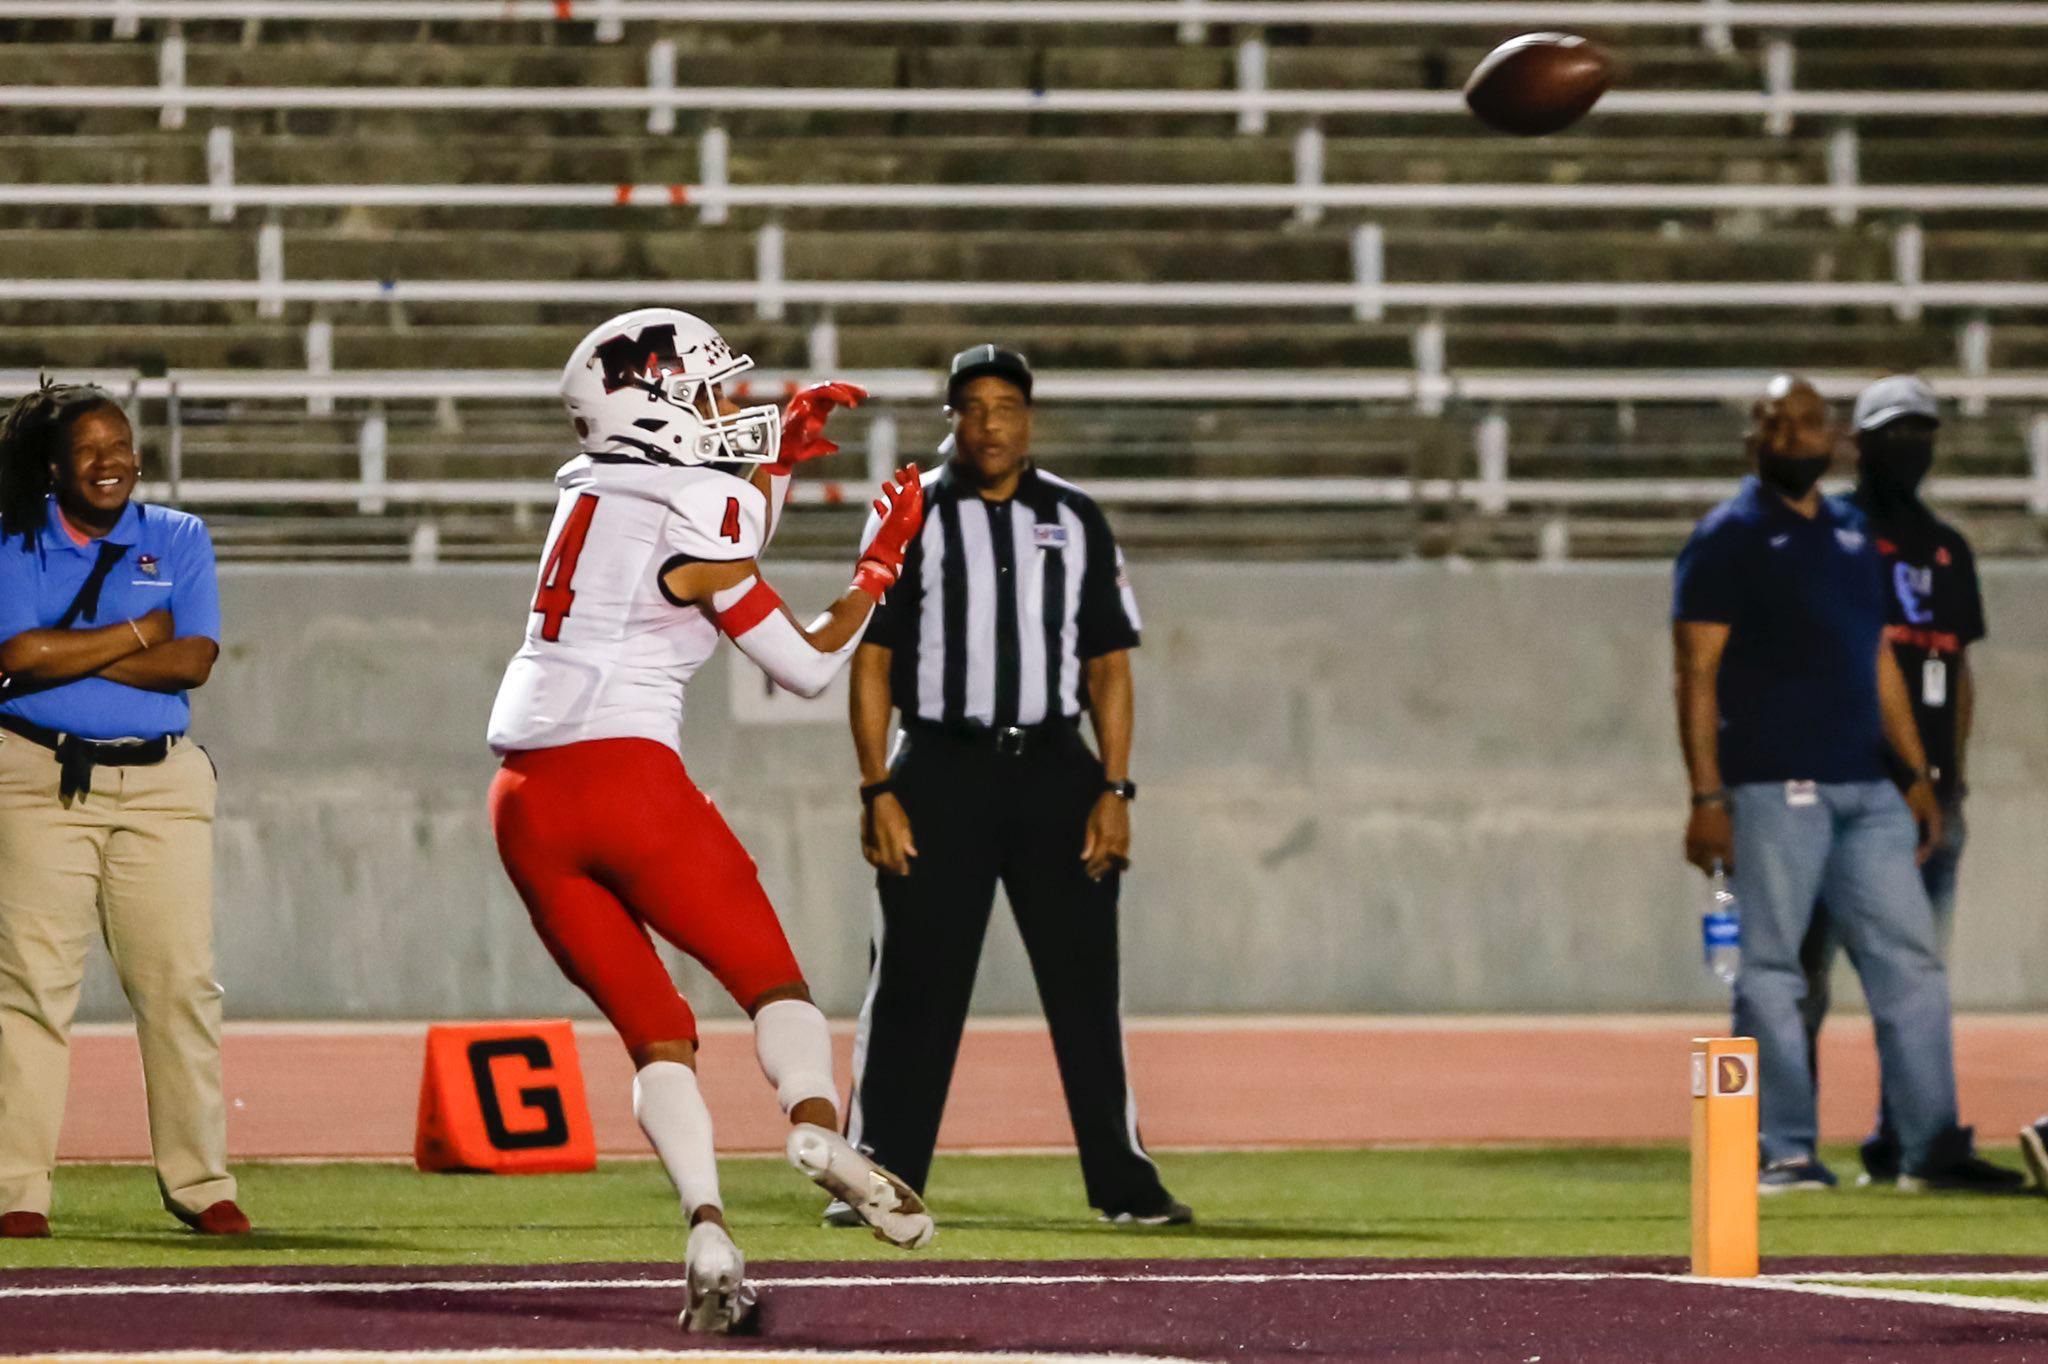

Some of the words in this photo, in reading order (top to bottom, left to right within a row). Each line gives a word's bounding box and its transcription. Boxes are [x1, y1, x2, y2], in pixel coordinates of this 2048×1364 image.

[595, 323, 686, 395] M
[720, 496, 740, 544] 4
[533, 492, 600, 642] 4
[467, 1035, 569, 1150] G
[1718, 1055, 1747, 1094] D
